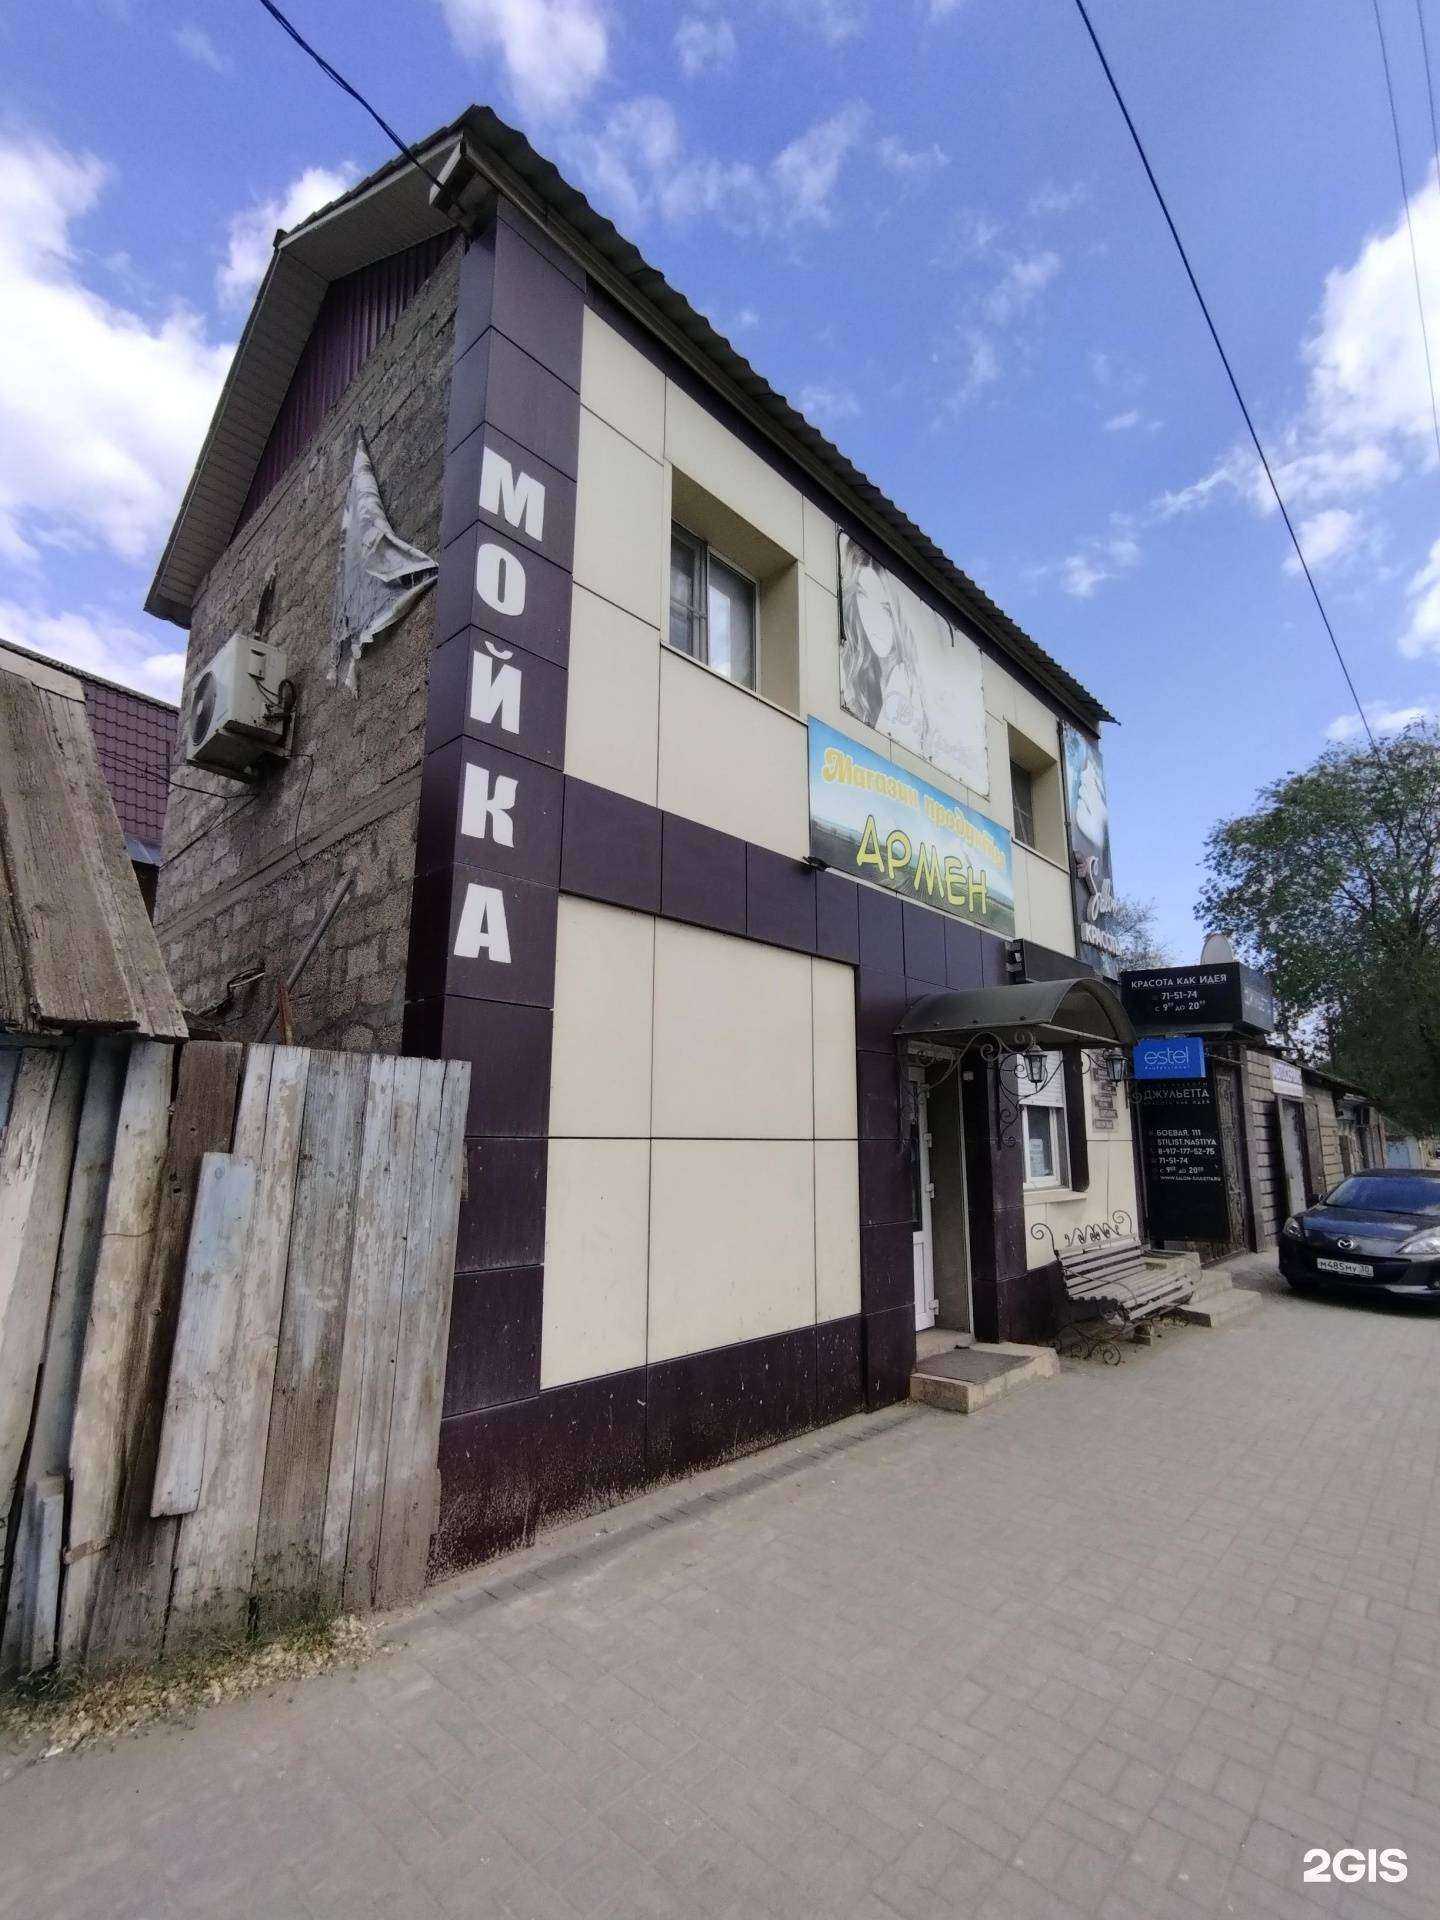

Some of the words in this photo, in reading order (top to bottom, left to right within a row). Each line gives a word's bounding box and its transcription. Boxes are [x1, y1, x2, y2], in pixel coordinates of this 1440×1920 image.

[453, 446, 546, 964] МОЙКА
[856, 814, 988, 914] АРМЕН
[1131, 978, 1174, 989] КРАСОТА
[1176, 976, 1197, 985] КАК
[1199, 974, 1227, 984] ИДЕЯ
[1161, 990, 1198, 1000] 71-51-74
[1144, 1046, 1190, 1065] estel
[1144, 1088, 1210, 1100] ДЖУЛЬЕТТА
